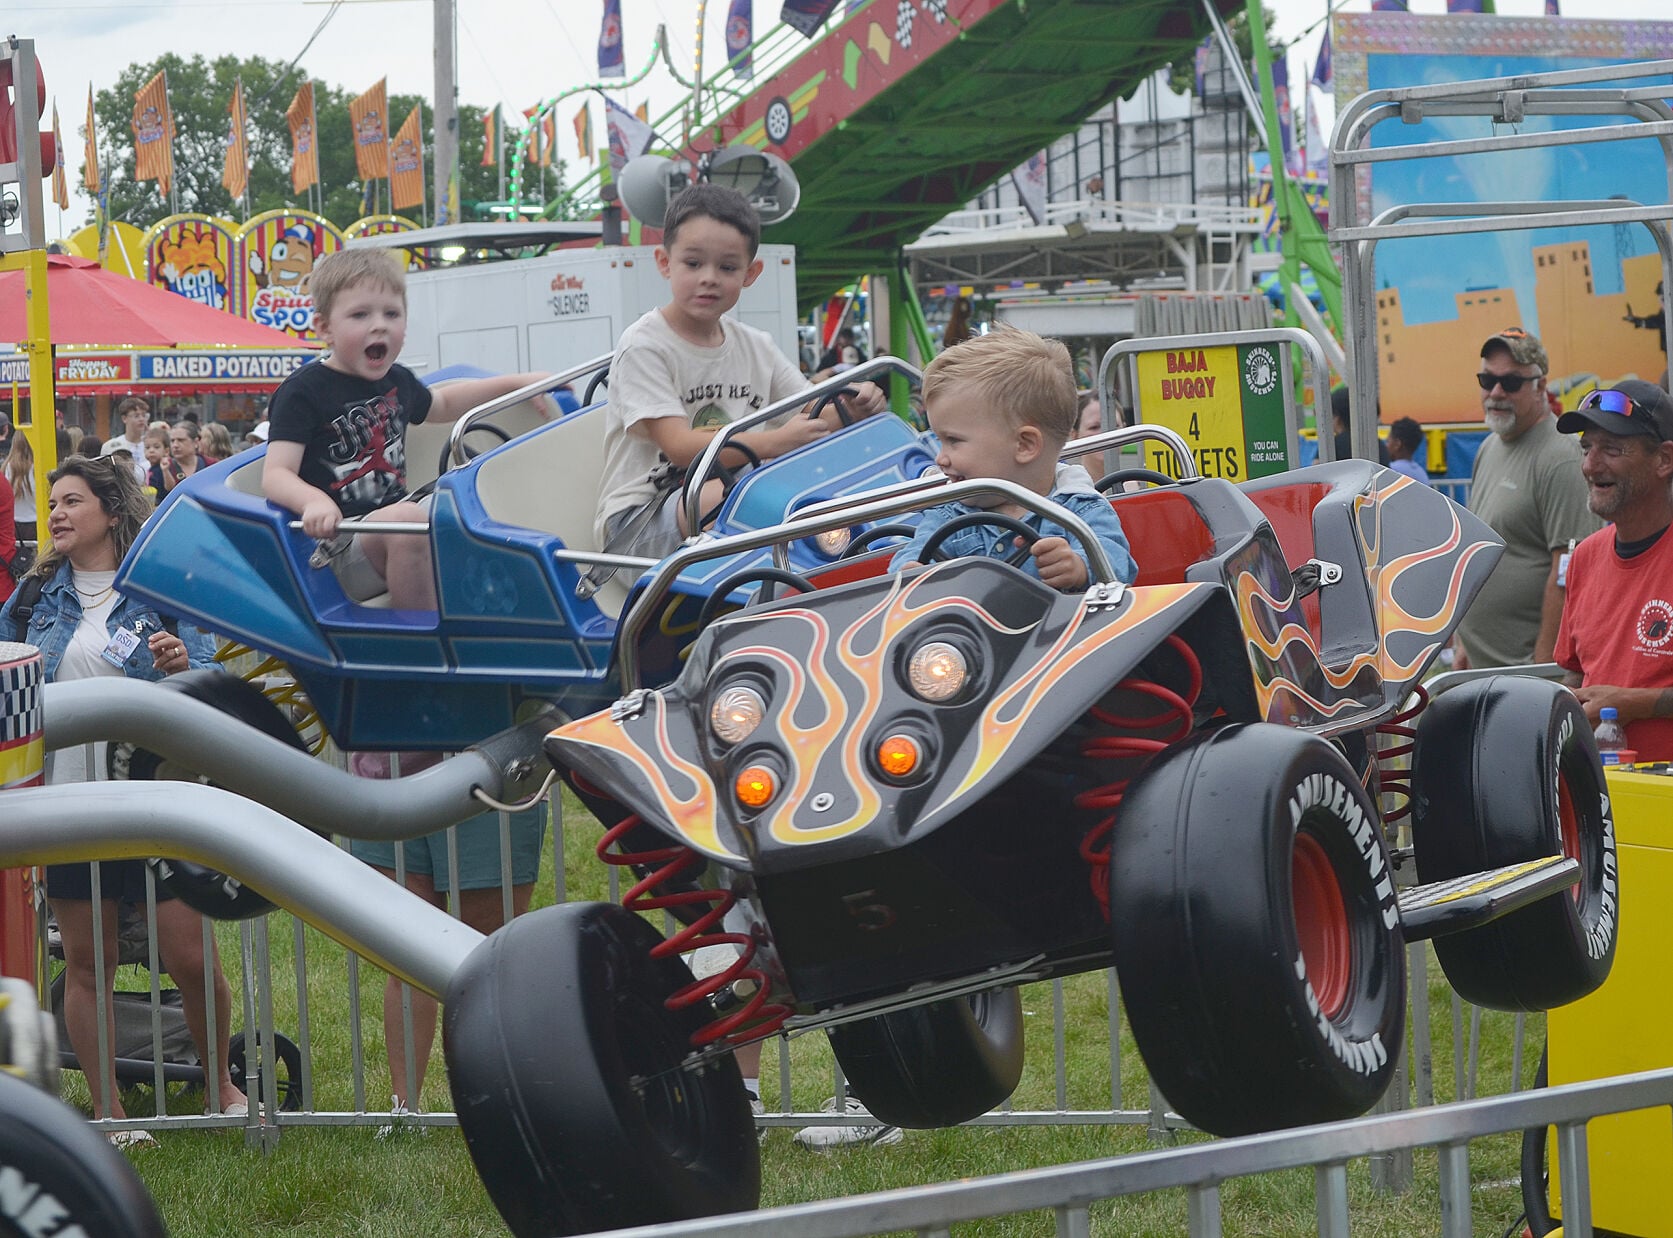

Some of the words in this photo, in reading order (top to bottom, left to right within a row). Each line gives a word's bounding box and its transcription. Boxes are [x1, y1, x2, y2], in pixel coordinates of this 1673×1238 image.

[58, 365, 119, 379] FRYDAY
[152, 356, 213, 378] BAKED
[215, 356, 303, 377] POTATOES
[1166, 349, 1208, 373] BAJA
[686, 383, 723, 403] JUST
[729, 383, 763, 409] HEE
[1162, 376, 1216, 400] BUGGY
[1189, 412, 1200, 441] 4
[1251, 453, 1264, 462] RIDE
[1265, 452, 1285, 461] ALONE
[1253, 441, 1265, 450] YOU
[1266, 441, 1279, 450] CAN
[1289, 772, 1400, 931] AMUSEMENTS
